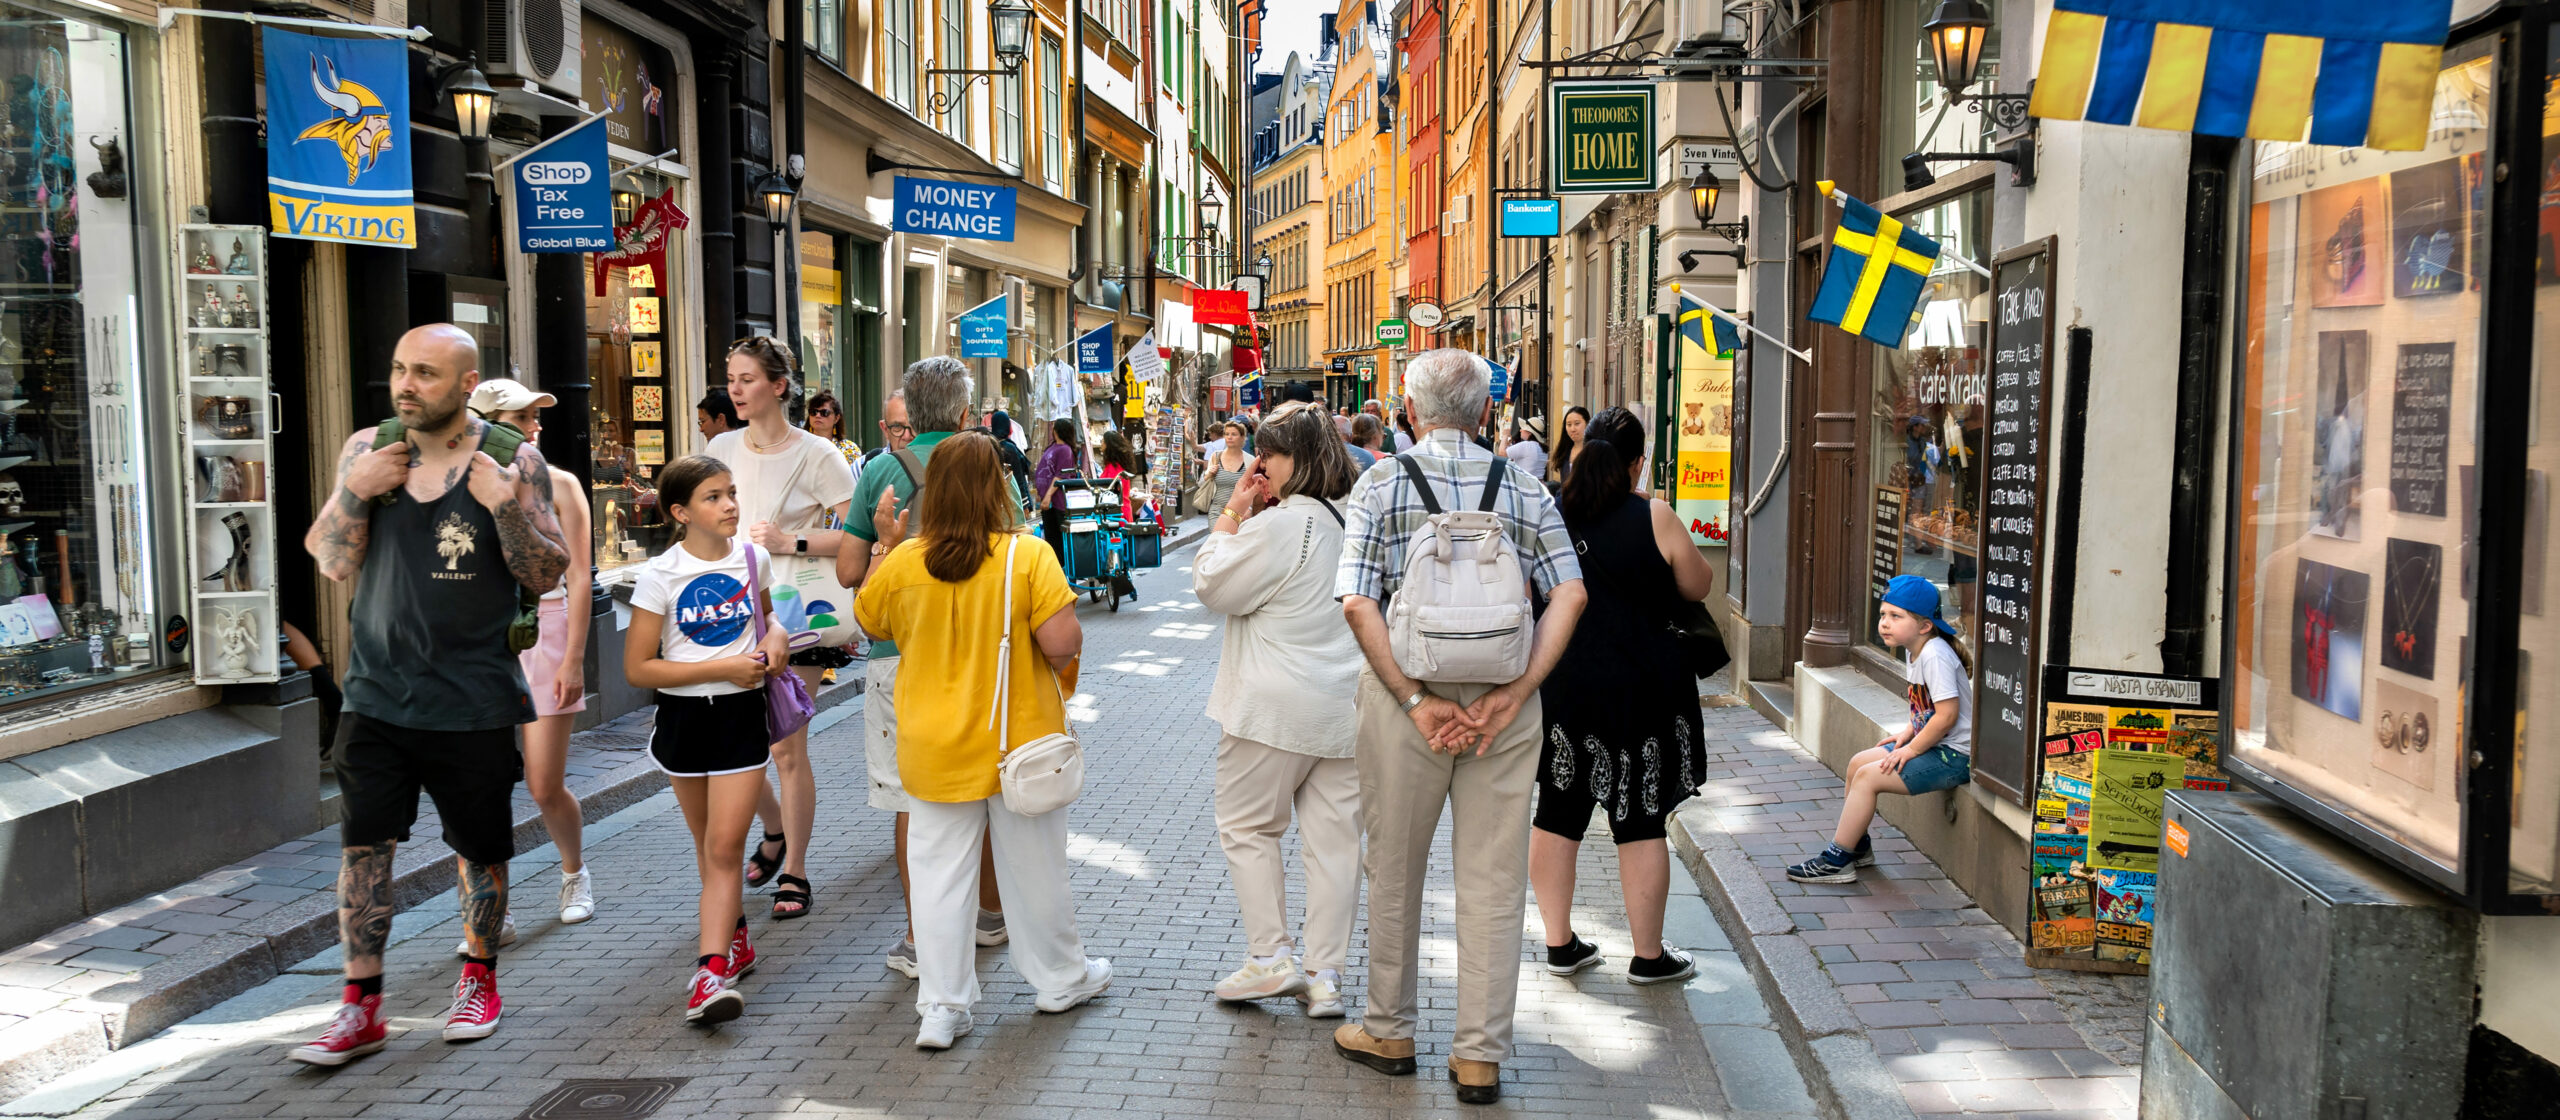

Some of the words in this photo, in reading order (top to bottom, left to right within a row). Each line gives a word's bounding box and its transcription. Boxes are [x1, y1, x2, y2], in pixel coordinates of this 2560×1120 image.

[1572, 106, 1638, 124] THEODORE'S
[1573, 132, 1639, 171] HOME
[1684, 147, 1707, 158] Sven
[528, 165, 586, 183] Shop
[1684, 165, 1688, 175] 1
[530, 187, 568, 202] Tax
[914, 184, 996, 210] MONEY
[537, 205, 584, 220] Free
[1507, 203, 1552, 213] Bankomat
[278, 195, 406, 242] VIKING
[905, 208, 1001, 235] CHANGE
[527, 238, 573, 249] Global
[575, 237, 607, 248] Blue
[1380, 328, 1403, 336] FOTO
[1081, 342, 1100, 350] SHOP
[1919, 363, 1947, 404] café
[680, 601, 753, 624] NASA
[2104, 675, 2142, 695] NÄSTA
[2055, 710, 2082, 722] JAMES
[2082, 711, 2104, 724] BOND
[2045, 738, 2070, 756] AGENT
[2070, 730, 2102, 753] X9
[2056, 779, 2077, 793] Min
[2039, 888, 2088, 902] TARZAN
[2096, 922, 2147, 943] SERIE
